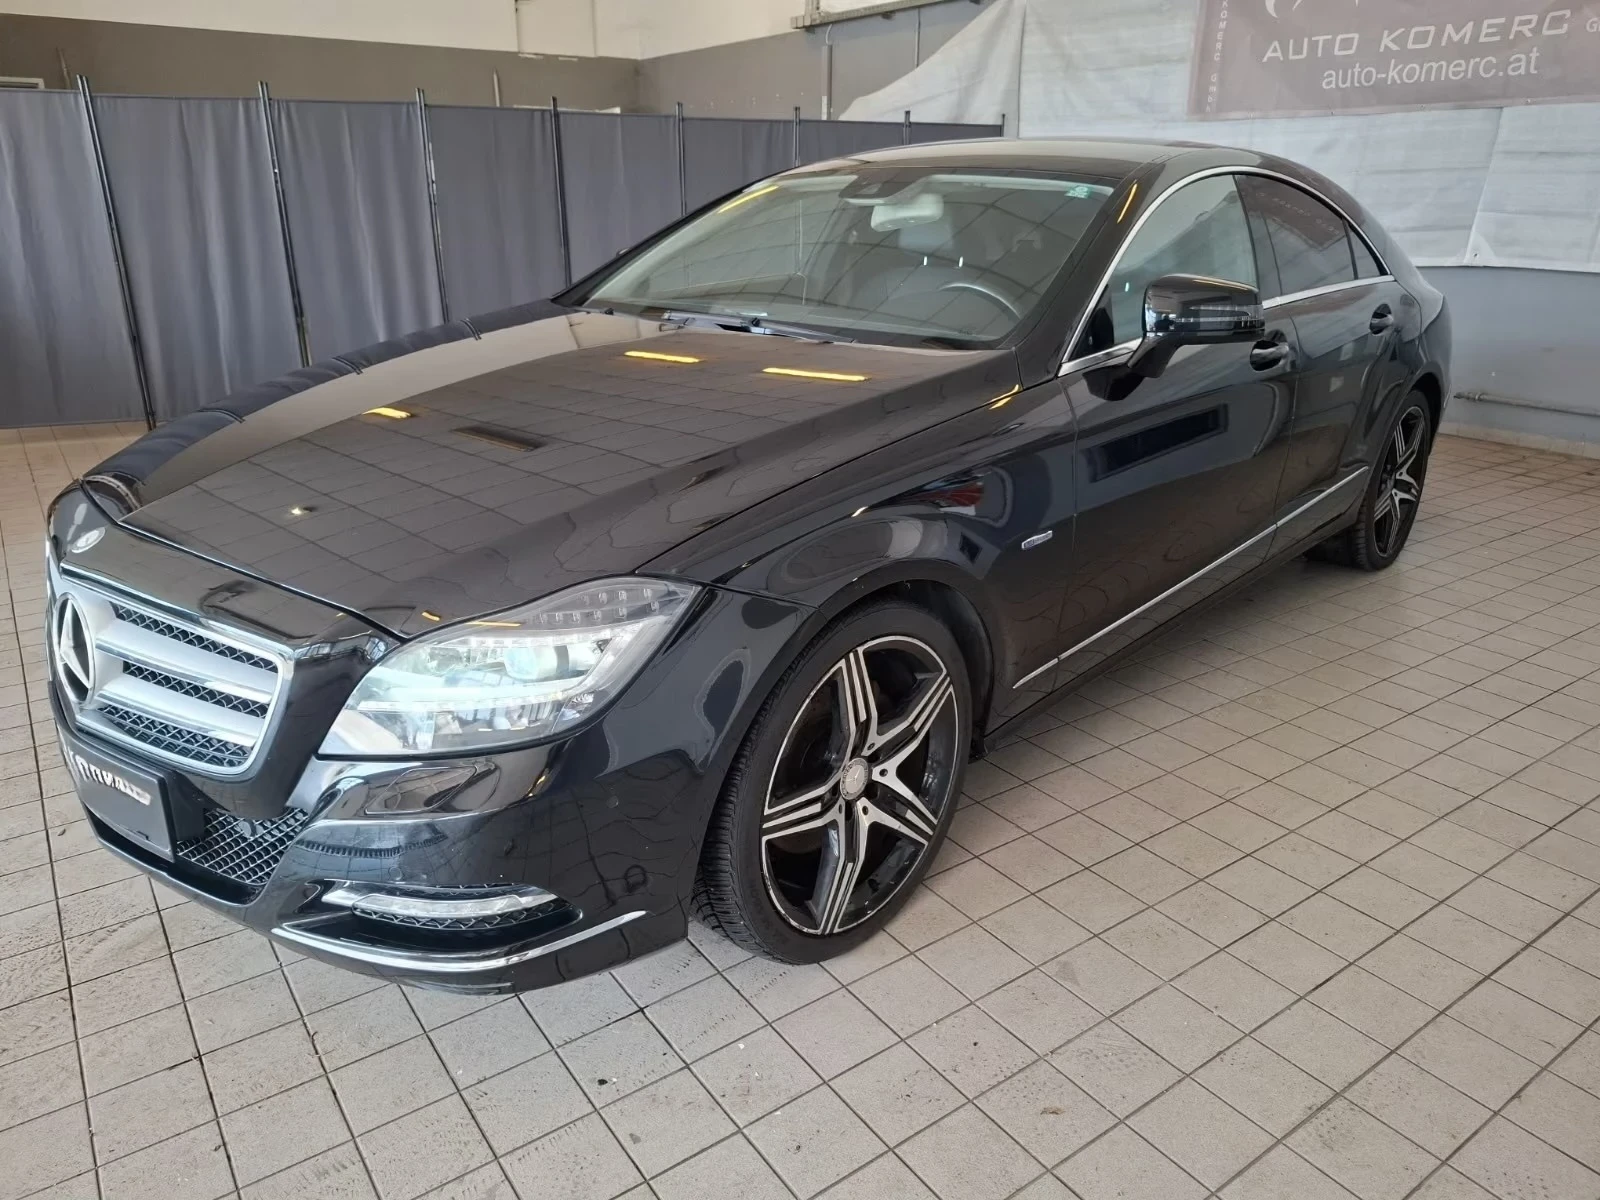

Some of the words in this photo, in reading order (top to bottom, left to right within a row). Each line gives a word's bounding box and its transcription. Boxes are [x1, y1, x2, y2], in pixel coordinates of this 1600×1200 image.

[1262, 33, 1360, 62] AUTO
[1379, 9, 1571, 52] KOMERC
[1322, 46, 1540, 89] auto-komerc.at
